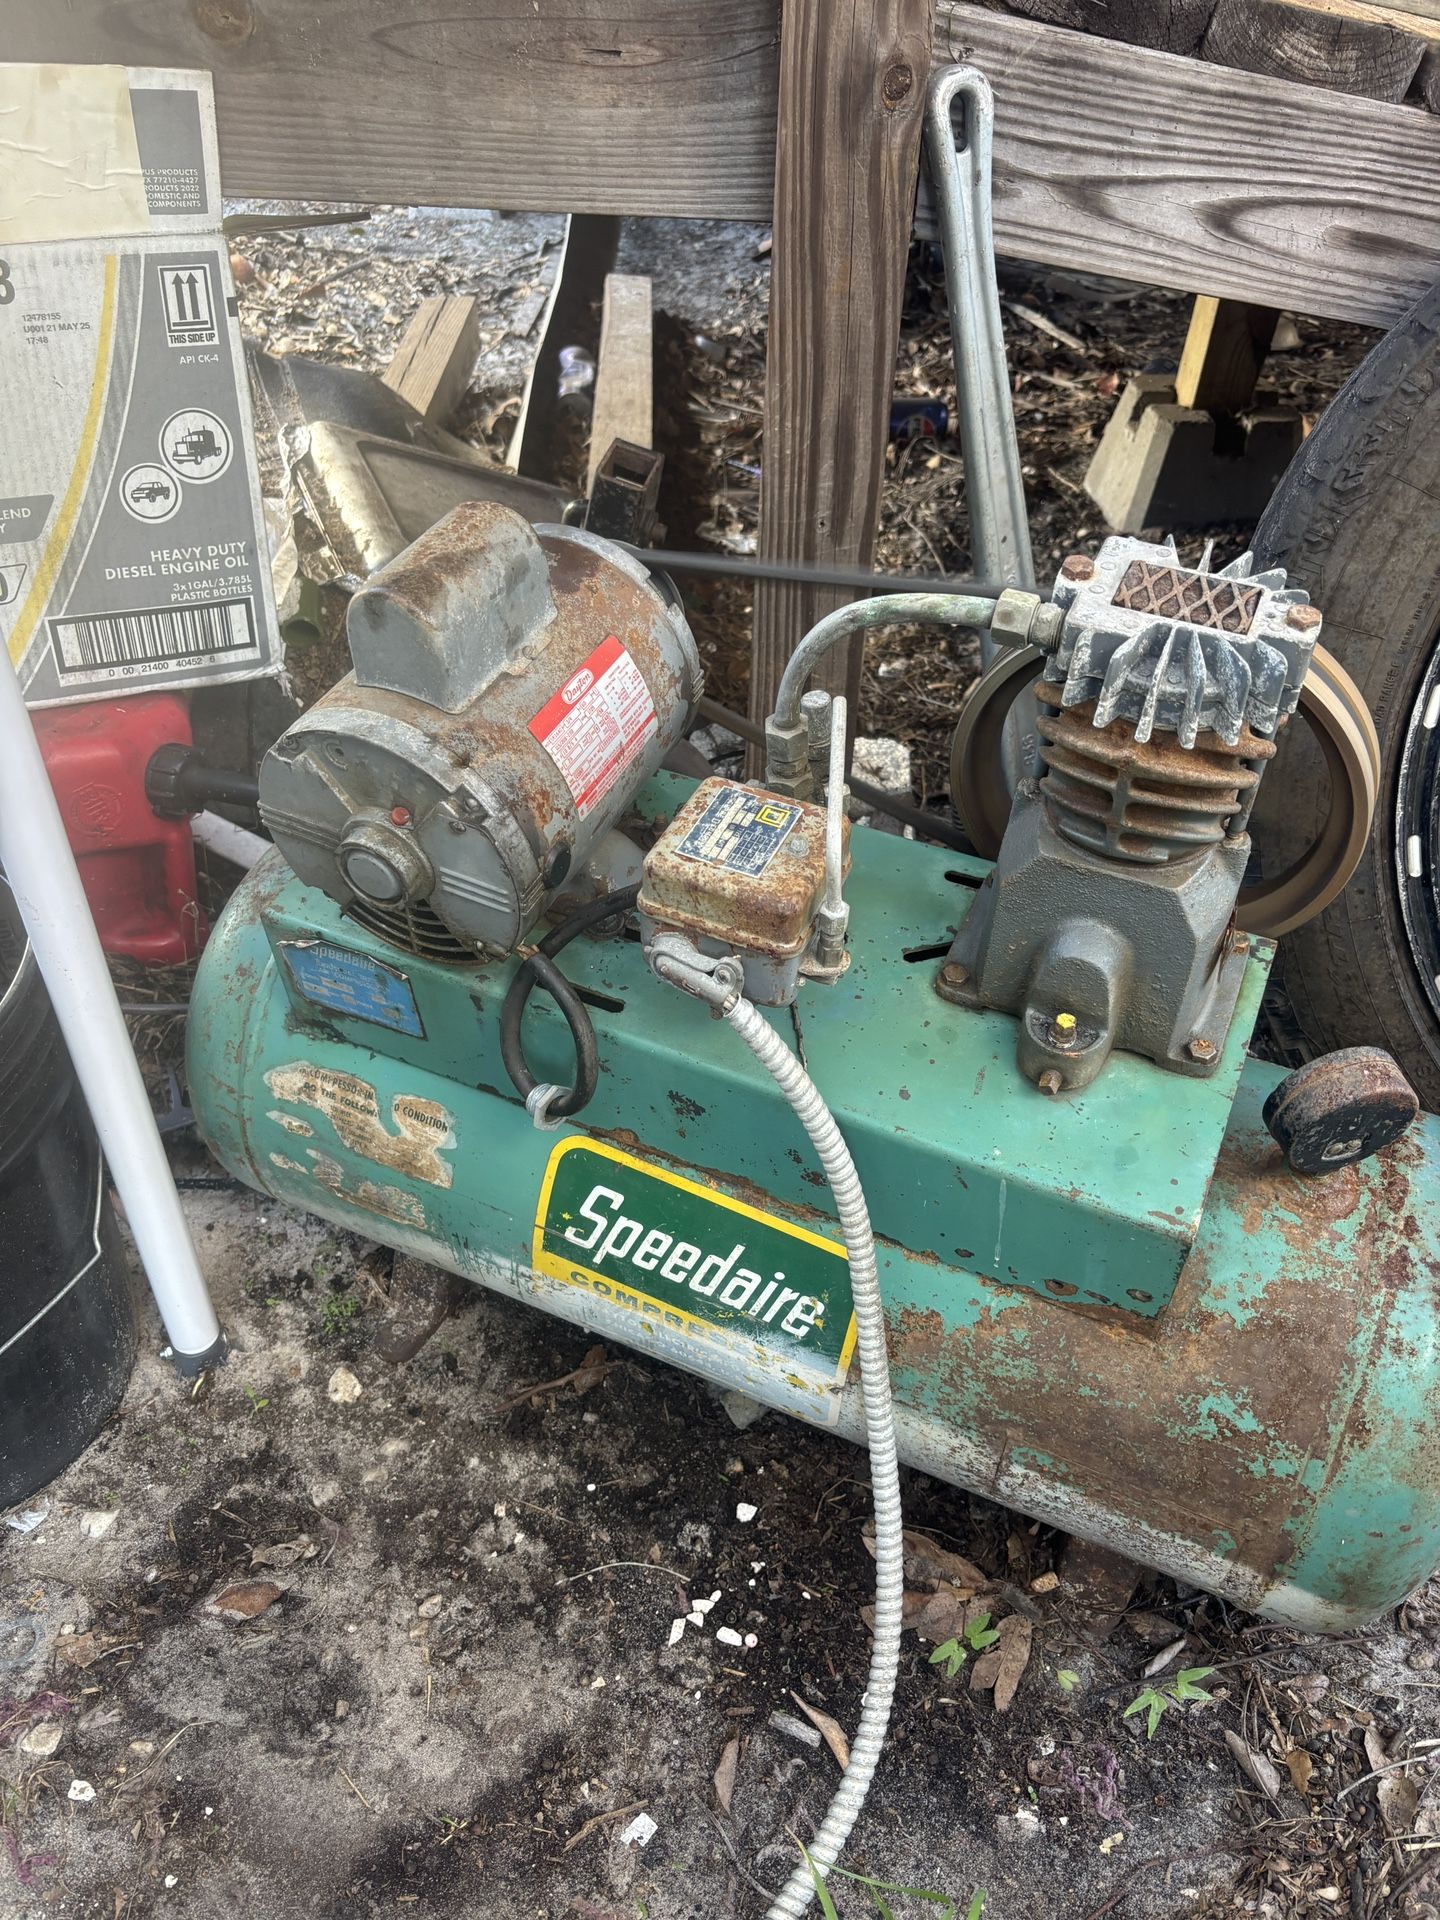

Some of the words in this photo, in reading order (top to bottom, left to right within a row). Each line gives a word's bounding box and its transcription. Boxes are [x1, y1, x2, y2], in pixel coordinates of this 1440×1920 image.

[46, 324, 57, 332] 21
[58, 322, 78, 331] MAY
[80, 322, 91, 330] 25
[26, 336, 49, 345] 17:48
[168, 334, 186, 344] THIS
[187, 332, 205, 343] SIDE
[205, 332, 216, 342] UP
[180, 355, 196, 364] API
[198, 354, 219, 363] CK-4
[0, 508, 31, 520] END
[150, 546, 202, 562] HEAVY
[207, 541, 246, 556] DUTY
[104, 564, 156, 580] DIESEL
[161, 558, 220, 575] ENGINE
[224, 555, 249, 568] OIL
[170, 590, 211, 602] PLASTIC
[213, 584, 253, 598] BOTTLES
[108, 669, 116, 677] 0
[122, 666, 134, 676] 00
[141, 662, 169, 672] 21400
[176, 657, 202, 668] 40452
[210, 655, 216, 663] 6
[565, 673, 591, 702] Dayton
[320, 1088, 337, 1100] THE
[402, 1106, 449, 1134] CONDITION
[564, 1184, 826, 1338] Speedaire
